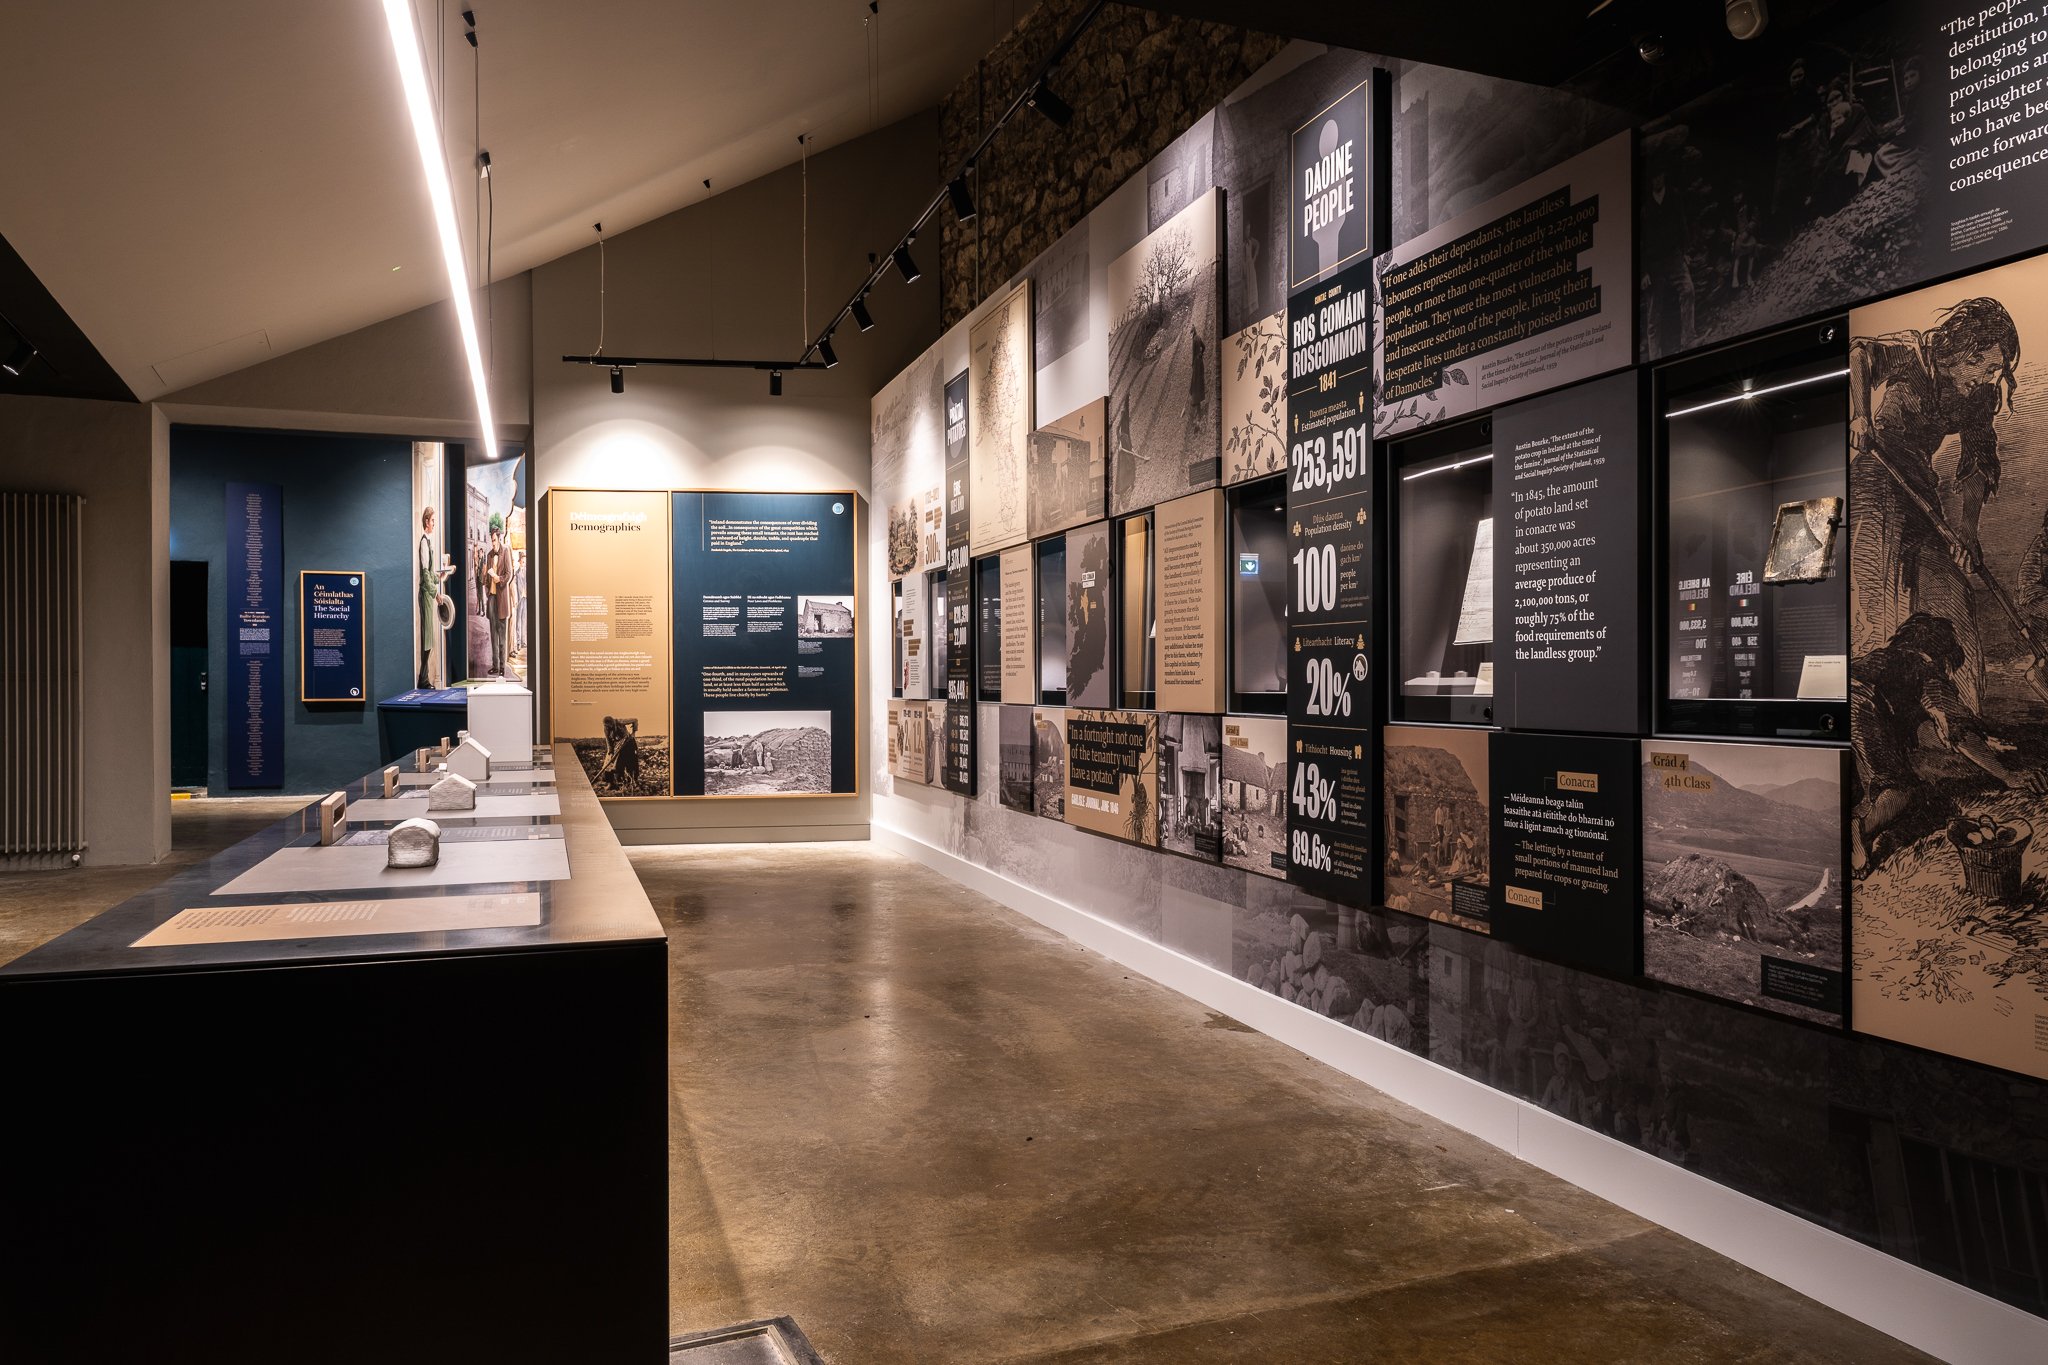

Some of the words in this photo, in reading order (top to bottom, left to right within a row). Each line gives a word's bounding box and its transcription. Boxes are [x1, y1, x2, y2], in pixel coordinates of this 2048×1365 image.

[1941, 16, 1975, 35] “The
[1979, 0, 2026, 27] peop
[1949, 12, 2039, 58] destitution,
[1950, 37, 2027, 80] belonging
[2030, 30, 2047, 45] to
[1950, 61, 2029, 108] provisions
[1950, 111, 1965, 124] to
[1969, 79, 2042, 117] slaughter
[1950, 127, 1982, 146] who
[1986, 112, 2021, 134] have
[1304, 139, 1353, 201] DAOINE
[1950, 147, 1989, 169] come
[1304, 177, 1354, 237] PEOPLE
[1382, 274, 1392, 288] “If
[1393, 272, 1407, 285] one
[1408, 260, 1427, 278] adds
[1429, 252, 1449, 268] their
[1450, 228, 1504, 258] dependants,
[1505, 217, 1521, 232] the
[1524, 197, 1564, 224] landless
[1386, 284, 1421, 307] labourers
[1423, 258, 1471, 292] represented
[1474, 258, 1479, 268] a
[1481, 244, 1502, 265] total
[1504, 237, 1514, 254] of
[1515, 226, 1544, 249] nearly
[1548, 206, 1595, 235] 2,272,000
[1294, 314, 1315, 348] ROS
[1320, 289, 1365, 336] COMÁIN
[1293, 322, 1366, 379] ROSCOMMON
[1319, 370, 1336, 392] 1841
[1386, 386, 1394, 400] of
[1395, 372, 1437, 397] Damocles.”
[1302, 415, 1326, 432] Estimated
[1327, 408, 1355, 427] population
[1292, 423, 1366, 493] 253,591
[1511, 492, 1523, 502] “In
[1526, 490, 1546, 500] 1845,
[1547, 485, 1561, 496] the
[1562, 478, 1598, 494] amount
[1515, 507, 1524, 520] of
[1525, 506, 1552, 521] potato
[1554, 500, 1573, 513] land
[1575, 499, 1588, 510] set
[570, 523, 640, 533] Demographics
[1304, 522, 1332, 536] Population
[1333, 519, 1352, 532] density
[1516, 526, 1524, 537] in
[1525, 524, 1557, 536] conacre
[1559, 521, 1575, 531] was
[1515, 543, 1538, 555] about
[1541, 540, 1571, 552] 350,000
[1573, 537, 1596, 547] acres
[1340, 570, 1356, 579] people
[1515, 558, 1568, 574] representing
[1570, 557, 1580, 566] an
[1293, 544, 1337, 613] 100
[1515, 579, 1546, 592] average
[1548, 573, 1584, 590] produce
[1586, 570, 1596, 583] of
[1515, 596, 1553, 609] 2,100,000
[1555, 594, 1578, 605] tons,
[1579, 593, 1589, 602] or
[1515, 612, 1548, 627] roughly
[1550, 612, 1566, 625] 75%
[1568, 609, 1578, 621] of
[1579, 609, 1594, 621] the
[1334, 636, 1354, 648] Literacy
[1516, 630, 1534, 642] food
[1535, 629, 1594, 643] requirements
[1596, 626, 1607, 639] of
[1515, 648, 1529, 659] the
[1531, 647, 1566, 659] landless
[1568, 646, 1602, 662] group.”
[1306, 658, 1351, 717] 20%
[1068, 725, 1078, 740] “In
[1079, 730, 1083, 740] a
[1084, 724, 1114, 748] fortnight
[1115, 731, 1128, 745] not
[1129, 734, 1143, 747] one
[1071, 743, 1079, 759] of
[1079, 744, 1090, 761] the
[1091, 748, 1120, 771] tenantry
[1122, 750, 1136, 768] will
[1330, 744, 1352, 760] Housing
[1653, 755, 1677, 768] Grád
[1680, 760, 1686, 770] 4
[1071, 762, 1086, 780] have
[1086, 770, 1090, 780] a
[1091, 769, 1116, 787] potato.”
[1559, 775, 1596, 788] Conacra
[1664, 776, 1681, 788] 4th
[1684, 776, 1711, 790] Class
[1292, 762, 1336, 822] 43%
[1511, 793, 1544, 805] Méideanna
[1545, 796, 1564, 810] beaga
[1566, 799, 1584, 809] talún
[1293, 830, 1331, 872] 89.6%
[1522, 840, 1534, 850] The
[1535, 842, 1556, 857] letting
[1557, 845, 1566, 858] by
[1572, 849, 1595, 860] tenant
[1596, 852, 1604, 862] of
[1515, 854, 1532, 863] small
[1533, 858, 1560, 868] portions
[1561, 860, 1569, 870] of
[1570, 864, 1601, 875] manured
[1602, 866, 1618, 878] land
[1515, 868, 1542, 879] prepared
[1543, 871, 1553, 880] for
[1554, 875, 1572, 886] crops
[1581, 880, 1610, 894] grazing.
[1508, 890, 1540, 905] Conacre
